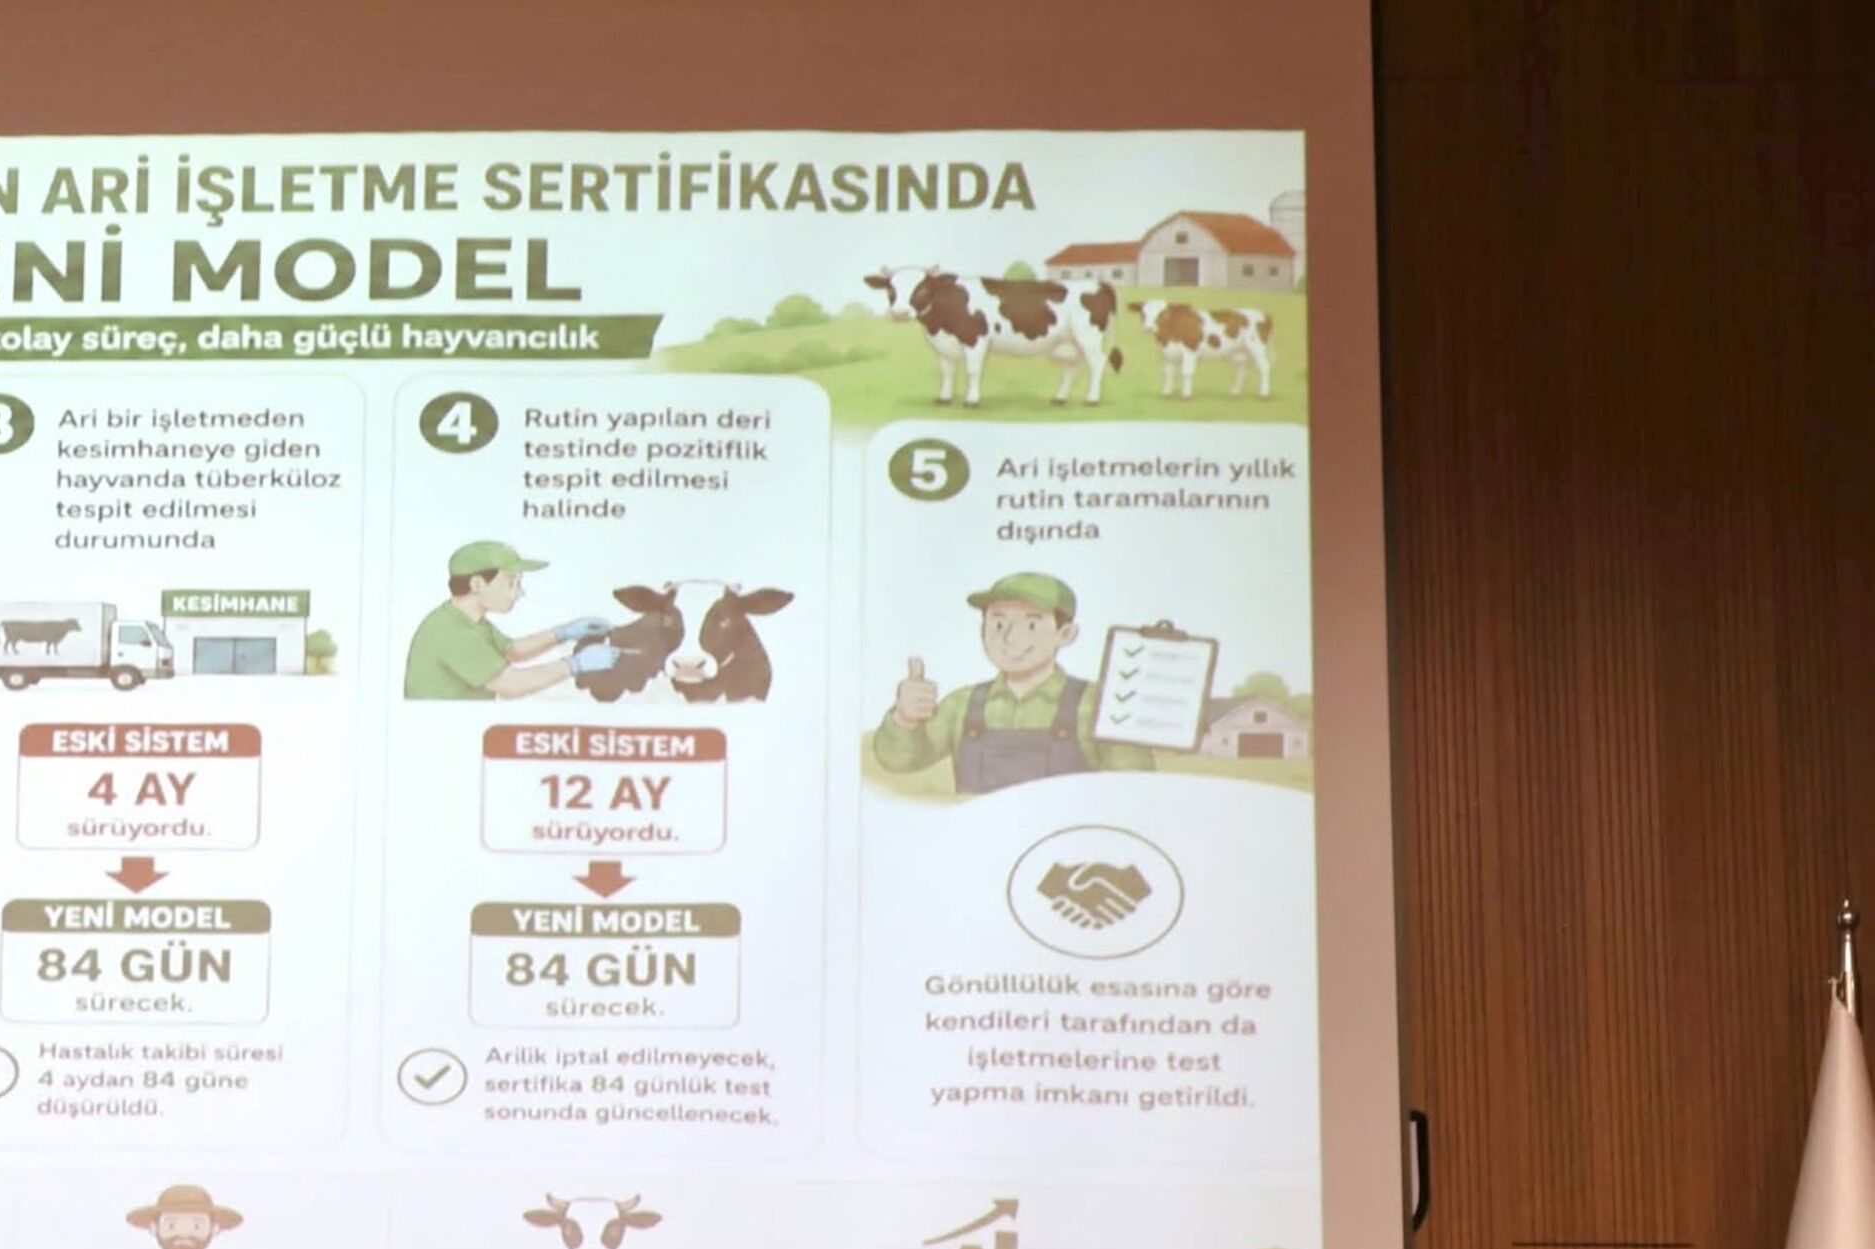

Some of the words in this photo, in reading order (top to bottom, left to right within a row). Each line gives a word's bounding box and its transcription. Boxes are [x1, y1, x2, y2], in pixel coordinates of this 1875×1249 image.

[41, 154, 149, 214] ARİ
[176, 153, 458, 228] İŞLETME
[482, 150, 1037, 215] SERTİFİKASINDA
[172, 237, 583, 303] MODEL
[81, 324, 187, 357] süreç,
[197, 323, 284, 351] daha
[292, 322, 392, 357] güçlü
[401, 323, 599, 355] hayvancılık
[58, 408, 98, 429] Ari
[106, 408, 142, 429] bir
[151, 407, 305, 434] işletmeden
[436, 401, 478, 445] 4
[524, 407, 598, 429] Rutin
[606, 406, 708, 433] yapılan
[715, 407, 771, 430] deri
[57, 438, 236, 464] kesimhaneye
[244, 438, 321, 463] giden
[523, 437, 638, 459] testinde
[646, 438, 768, 463] pozitiflik
[56, 468, 186, 494] hayvanda
[194, 467, 342, 489] tüberküloz
[523, 468, 602, 493] tespit
[610, 467, 729, 491] edilmesi
[910, 448, 948, 492] 5
[996, 457, 1039, 478] Ari
[1048, 455, 1221, 483] işletmelerin
[1228, 456, 1297, 485] yıllık
[55, 499, 133, 524] tespit
[141, 499, 257, 519] edilmesi
[522, 498, 627, 519] halinde
[996, 488, 1065, 510] rutin
[1073, 487, 1271, 511] taramalarının
[996, 519, 1100, 546] dışında
[172, 593, 303, 613] KESİMHANE
[52, 725, 116, 753] ESKİ
[124, 725, 229, 754] SİSTEM
[515, 728, 580, 755] ESKİ
[588, 728, 696, 758] SİSTEM
[87, 771, 118, 806] 4
[135, 771, 196, 806] AY
[540, 774, 593, 810] 12
[609, 775, 671, 811] AY
[532, 820, 679, 847] sürüyordu.
[512, 905, 583, 934] YENİ
[592, 909, 700, 934] MODEL
[37, 947, 102, 982] 84
[120, 939, 231, 983] GÜN
[505, 952, 570, 987] 84
[586, 944, 696, 988] GÜN
[924, 973, 1081, 996] Gönüllülük
[1089, 981, 1198, 999] esasına
[1205, 978, 1273, 1005] göre
[925, 1009, 1050, 1031] kendileri
[1060, 1012, 1213, 1036] tarafından
[1219, 1013, 1259, 1038] da
[38, 1042, 133, 1061] Hastalık
[141, 1043, 207, 1062] takibi
[213, 1044, 284, 1062] süresi
[967, 1046, 1158, 1073] işletmelerine
[1165, 1051, 1222, 1073] test
[37, 1069, 54, 1087] 4
[62, 1070, 134, 1092] aydan
[142, 1070, 176, 1089] 84
[184, 1071, 249, 1094] güne
[484, 1075, 583, 1094] sertifika
[591, 1074, 625, 1093] 84
[633, 1075, 717, 1098] günlük
[724, 1078, 771, 1098] test
[930, 1086, 1026, 1107] yapma
[1034, 1081, 1130, 1107] imkanı
